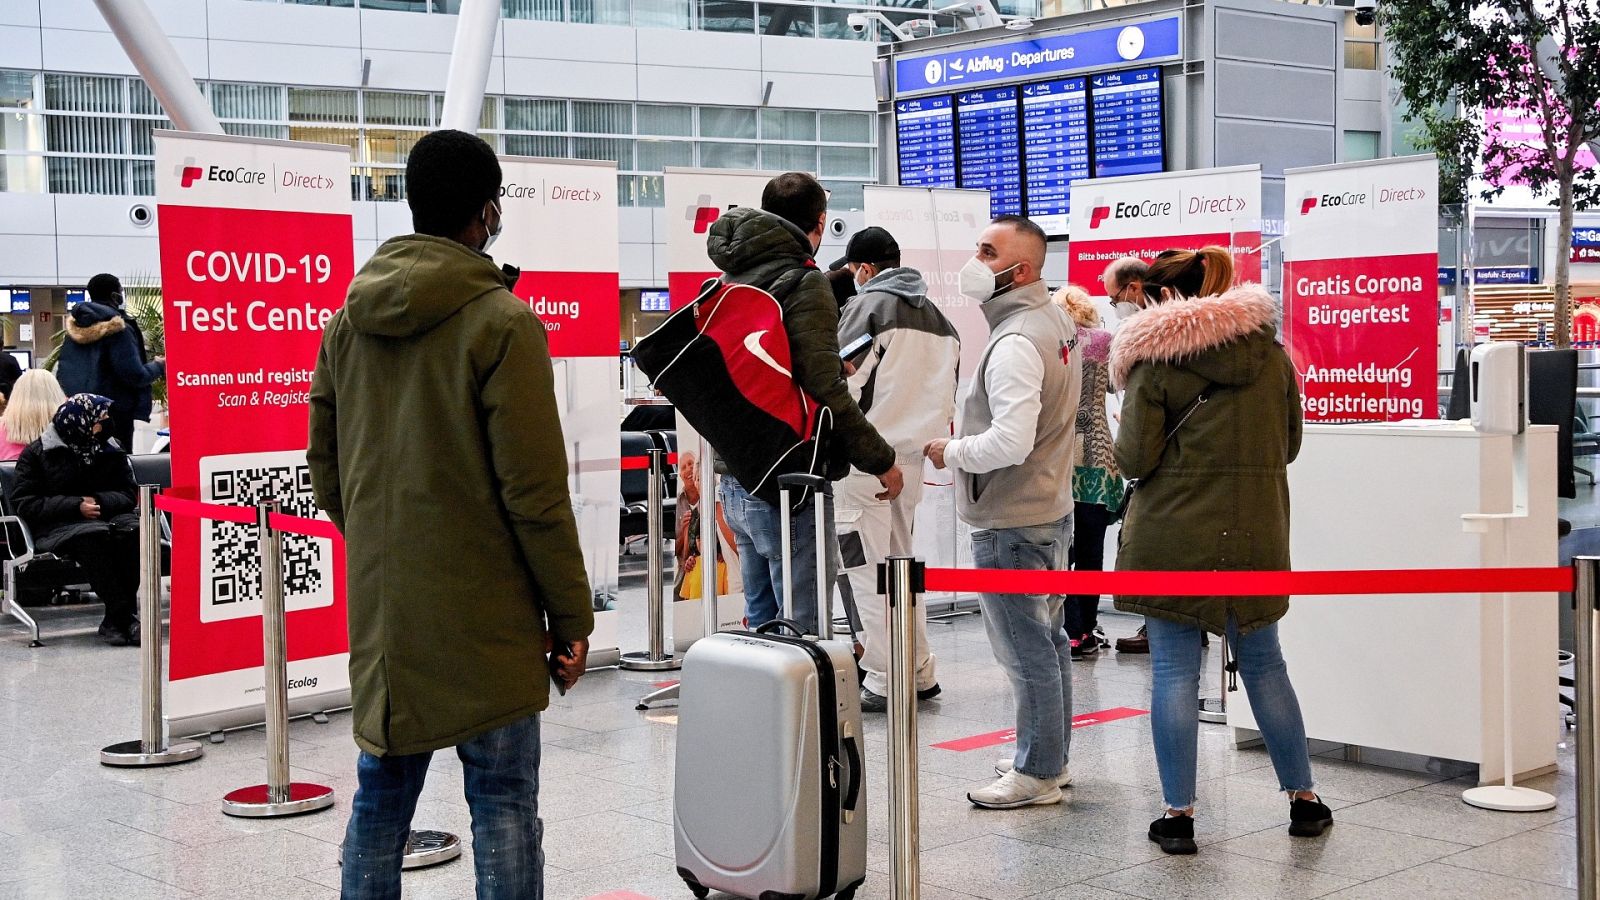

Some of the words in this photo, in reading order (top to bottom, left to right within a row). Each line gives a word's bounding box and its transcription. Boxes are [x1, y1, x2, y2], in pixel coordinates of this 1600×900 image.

[966, 56, 1004, 73] Abflug
[1011, 47, 1075, 68] Departures
[208, 165, 266, 185] EcoCare
[500, 183, 536, 199] oCare
[1321, 192, 1366, 207] EcoCare
[1115, 200, 1171, 219] EcoCare
[1078, 252, 1095, 261] Bitte
[1096, 251, 1127, 260] beachten
[1129, 250, 1139, 258] Sie
[186, 250, 331, 283] COVID-19
[1297, 274, 1350, 296] Gratis
[1355, 274, 1423, 293] Corona
[173, 301, 238, 331] Test
[246, 301, 338, 331] Cente
[1308, 304, 1410, 328] Bürgertest
[177, 371, 233, 386] Scannen
[237, 368, 263, 384] und
[268, 367, 314, 386] registr
[1305, 363, 1412, 388] Anmeldung
[217, 392, 246, 407] Scan
[250, 391, 260, 405] &
[263, 390, 310, 408] Registe
[288, 677, 318, 689] Ecolog
